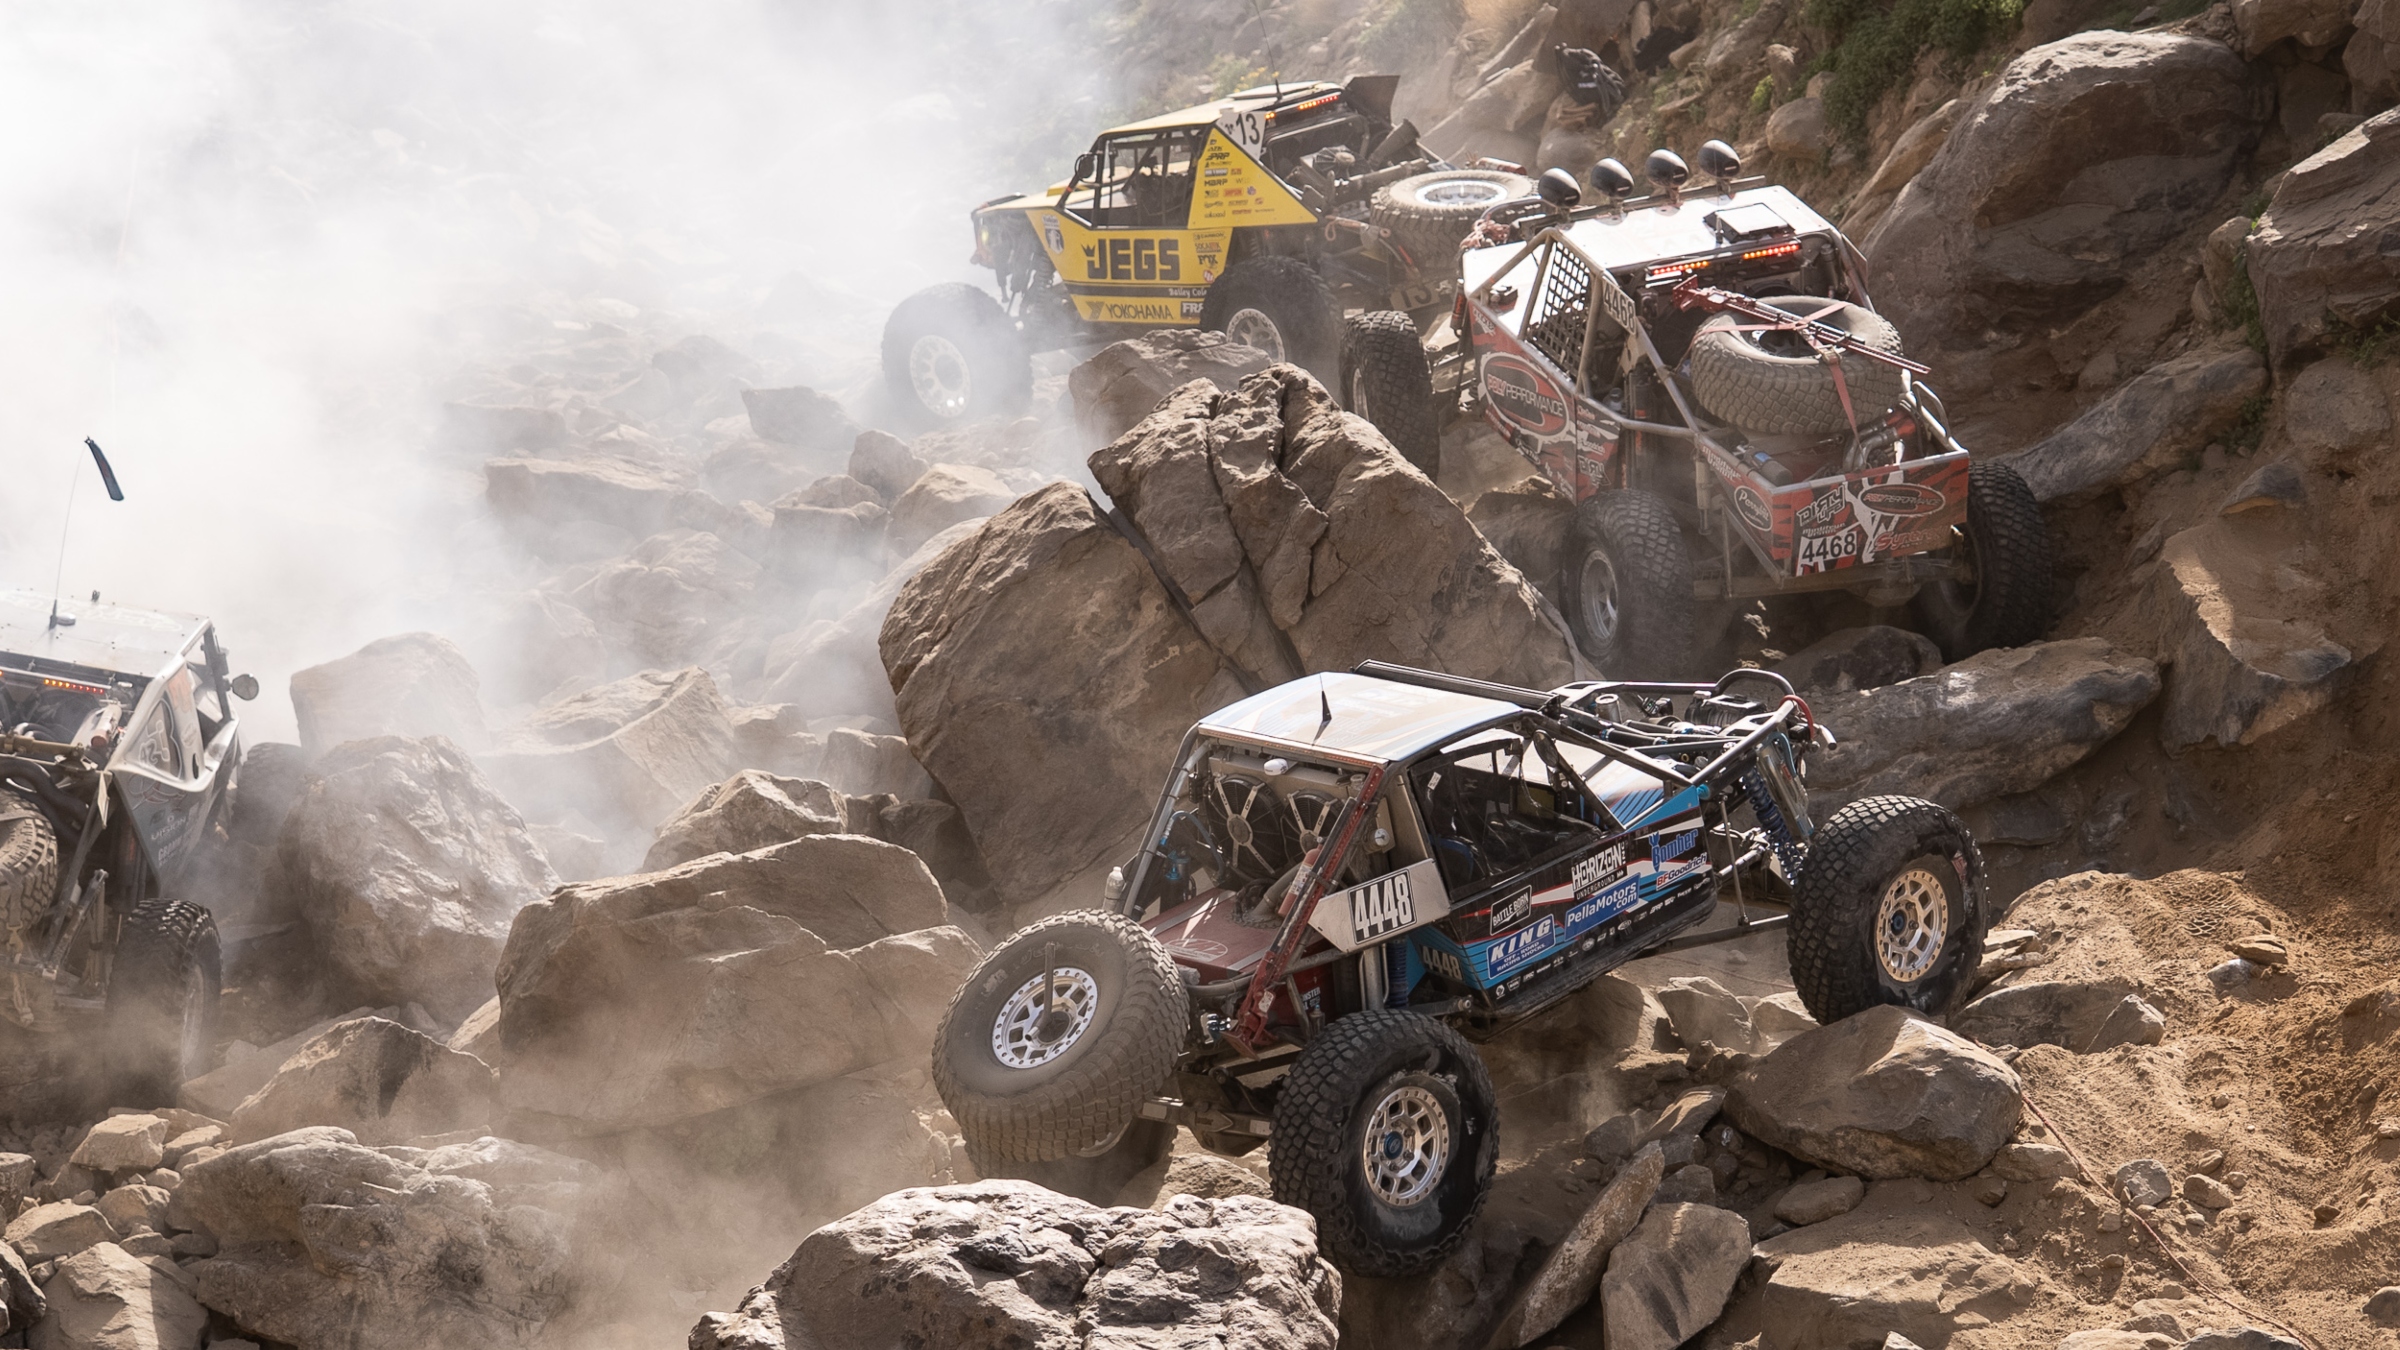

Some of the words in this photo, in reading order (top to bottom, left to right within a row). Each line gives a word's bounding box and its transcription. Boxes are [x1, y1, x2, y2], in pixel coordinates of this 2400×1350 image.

[1236, 113, 1260, 146] 13
[1087, 238, 1180, 281] JEGS
[1106, 303, 1174, 320] YOKOHAMA
[1603, 281, 1635, 334] 4468
[1505, 383, 1563, 417] PERFORMANCE
[1883, 494, 1940, 506] PERFORMANCE
[1802, 532, 1856, 563] 4468
[1652, 829, 1698, 865] Bomber
[1571, 843, 1622, 891] HORIZON
[1656, 852, 1708, 887] BFGoodrich
[1567, 882, 1637, 927] PellaMotors
[1576, 874, 1615, 900] UNDERGROUND
[1613, 892, 1637, 911] .com
[1355, 873, 1412, 938] 4448
[1492, 903, 1514, 927] BATTLE
[1513, 892, 1529, 911] BORN
[1491, 919, 1551, 962] KING
[1422, 946, 1463, 981] 4448
